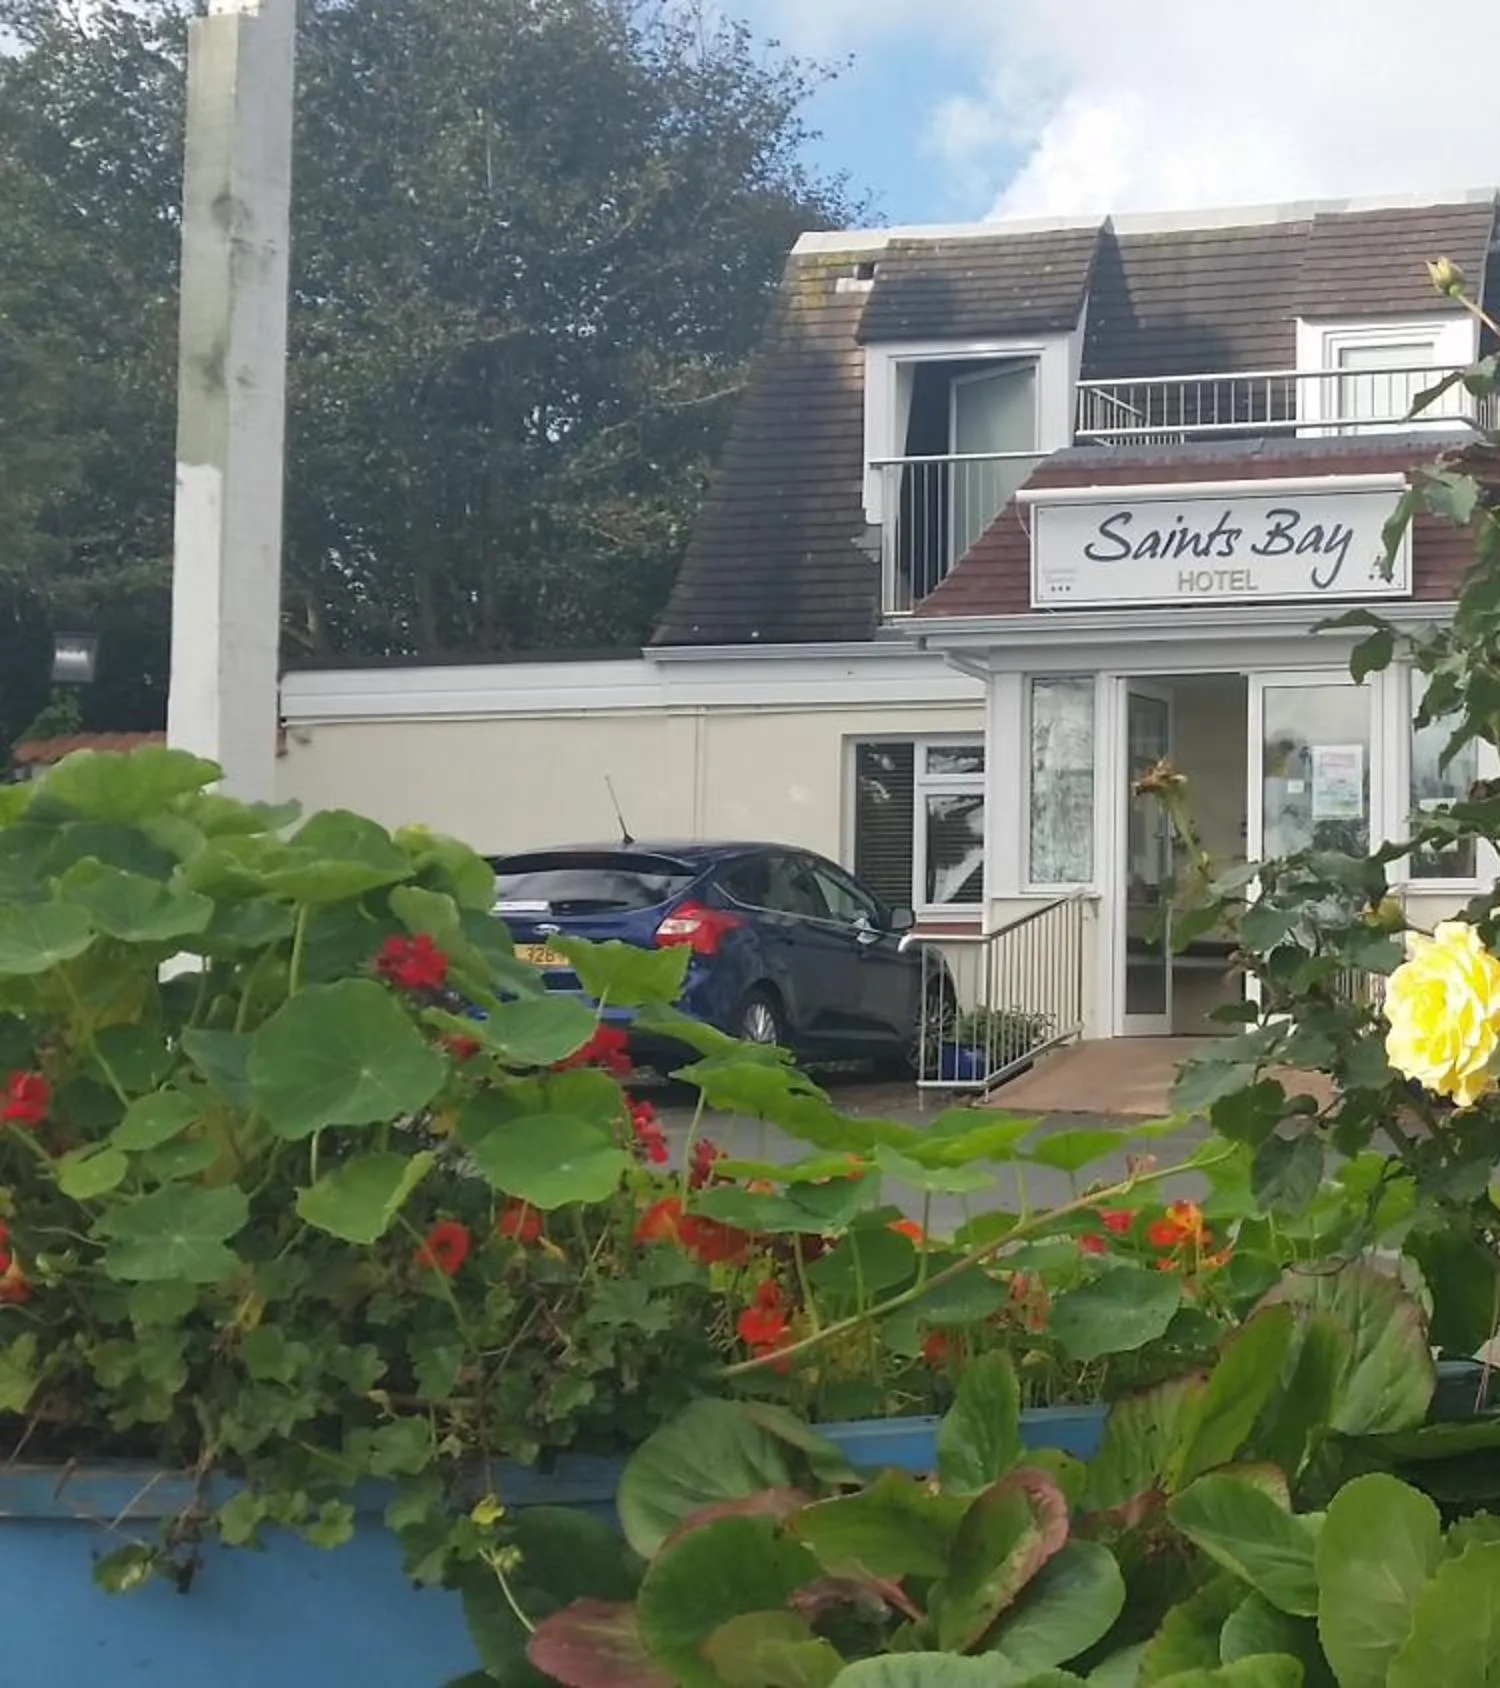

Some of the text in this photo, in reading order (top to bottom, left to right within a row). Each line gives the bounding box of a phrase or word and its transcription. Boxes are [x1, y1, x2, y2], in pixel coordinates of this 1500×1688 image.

[1084, 507, 1353, 589] Saints Bay
[1178, 569, 1259, 592] HOTEL
